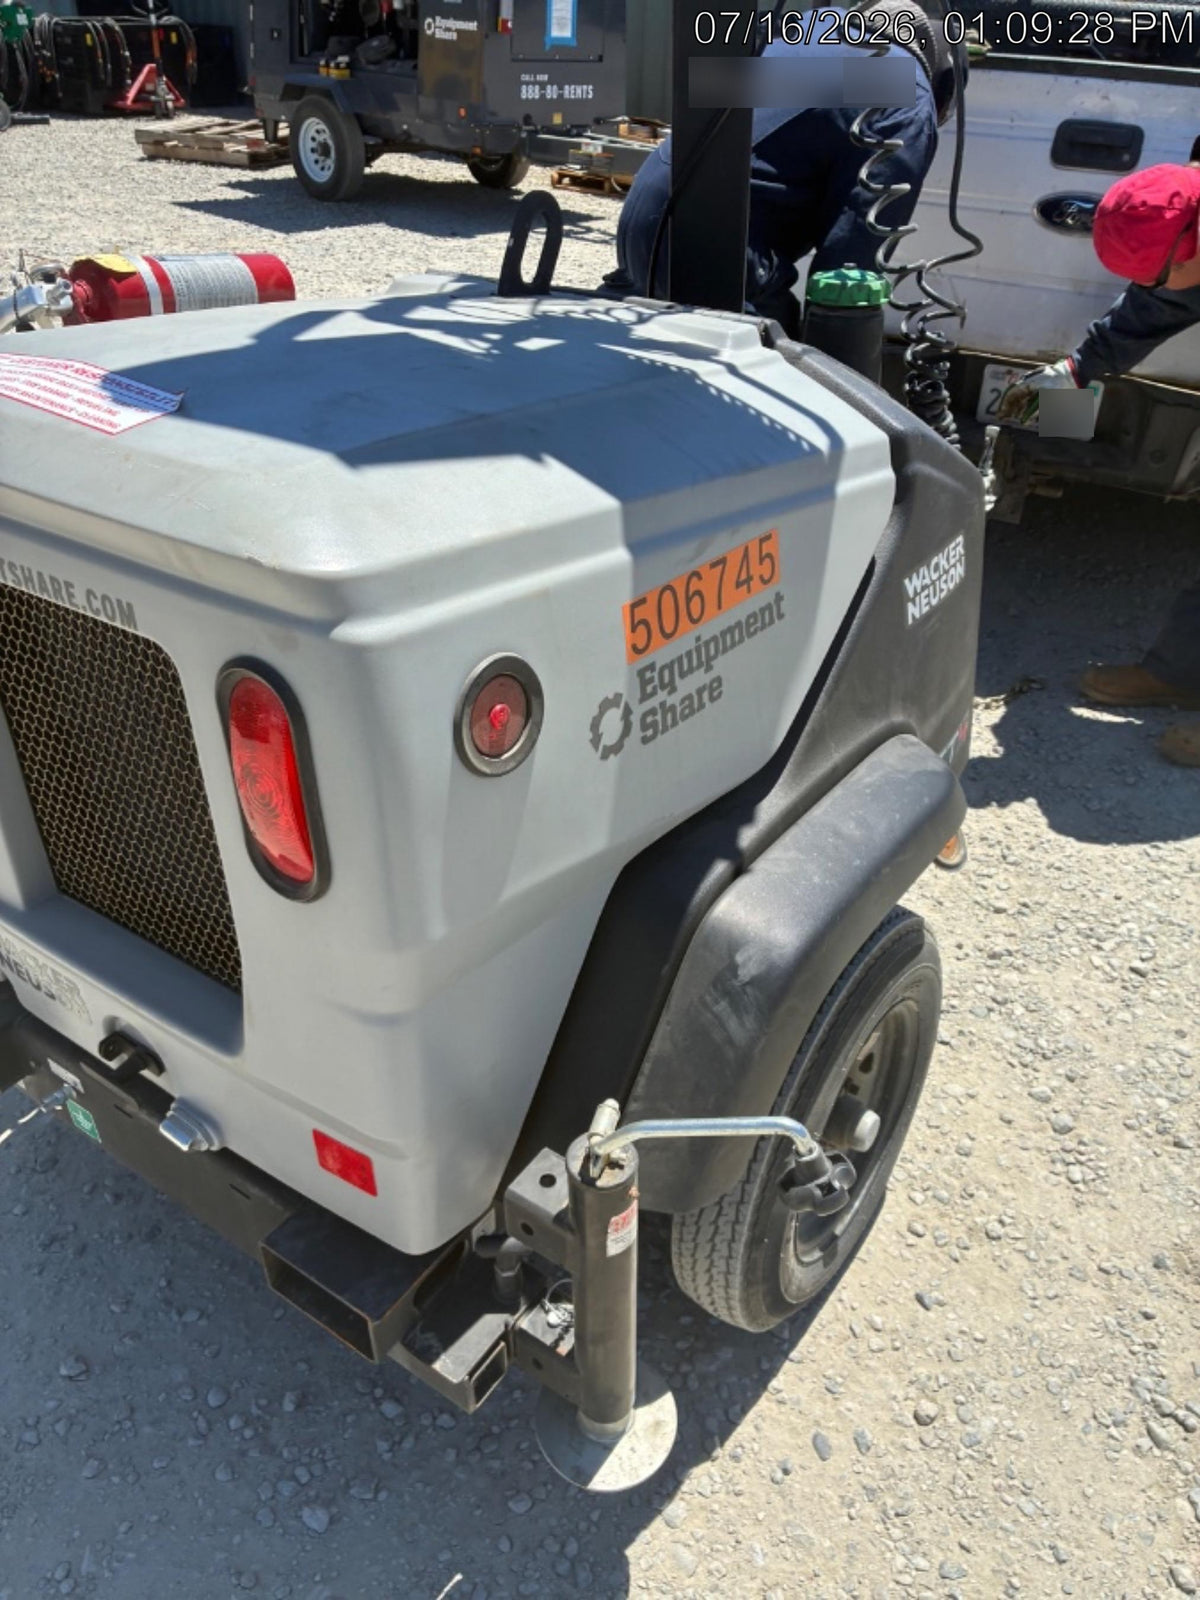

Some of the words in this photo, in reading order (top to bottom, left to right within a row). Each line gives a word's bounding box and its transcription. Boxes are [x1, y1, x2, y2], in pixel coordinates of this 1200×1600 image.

[435, 16, 478, 31] Equipment
[435, 28, 458, 41] Share
[520, 84, 594, 100] 888-80-RENTS
[629, 533, 777, 656] 506745
[903, 533, 965, 599] WACKER
[907, 556, 966, 625] NEUSON
[636, 591, 785, 705] Equipment
[639, 675, 723, 746] Share
